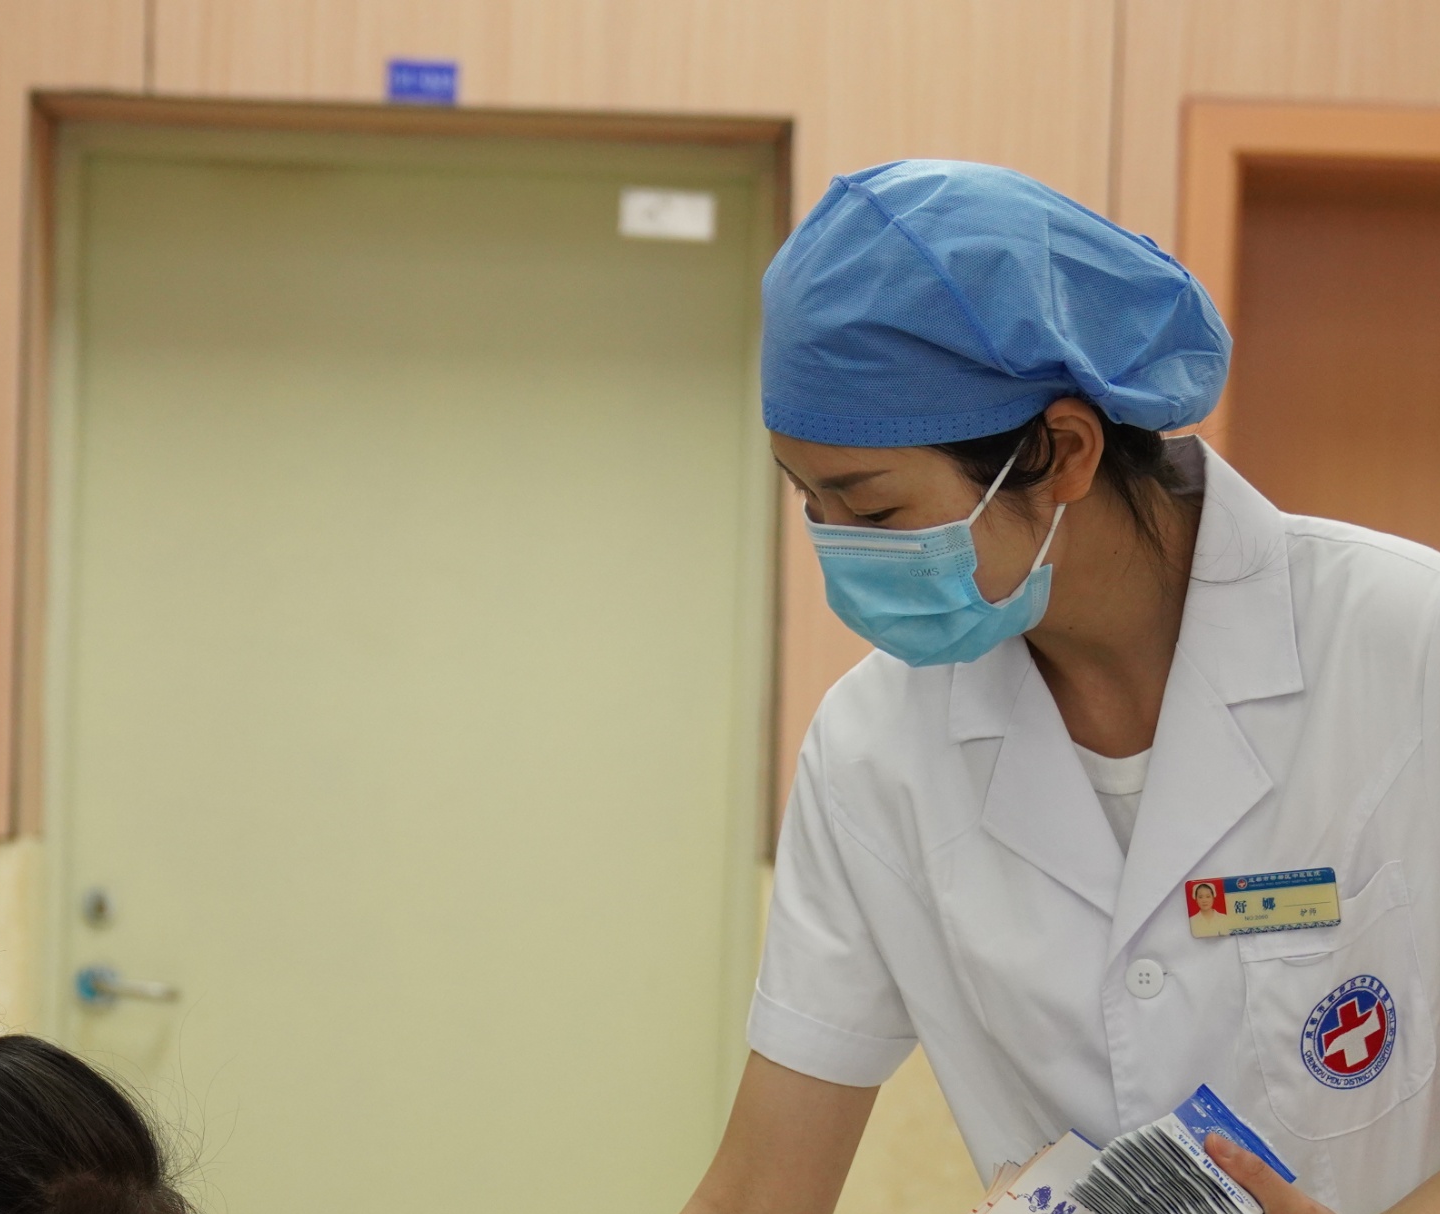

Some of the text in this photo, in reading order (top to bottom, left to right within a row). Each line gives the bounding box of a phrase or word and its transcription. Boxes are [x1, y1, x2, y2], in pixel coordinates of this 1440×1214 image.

[1305, 1049, 1327, 1079] CHENGDU
[1343, 1070, 1374, 1086] DISTRICT
[1373, 1040, 1392, 1073] HOSPITAL
